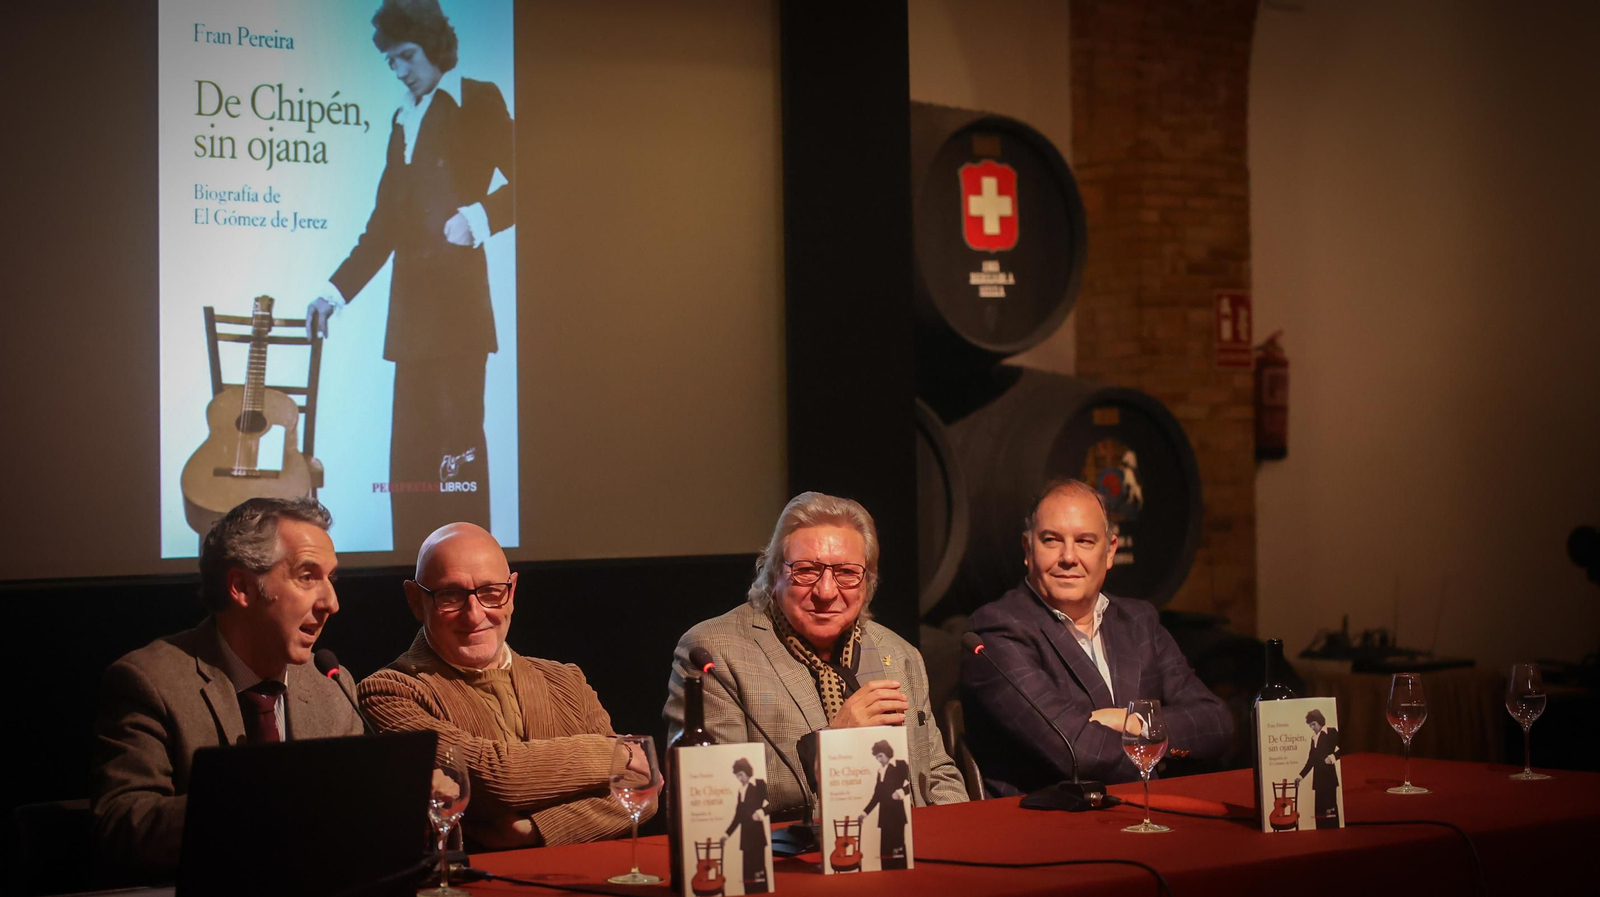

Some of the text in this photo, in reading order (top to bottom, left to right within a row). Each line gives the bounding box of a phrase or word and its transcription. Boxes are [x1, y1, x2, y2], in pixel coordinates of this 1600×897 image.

[193, 23, 295, 51] Fran Pereira
[193, 79, 371, 134] De Chipén,
[193, 122, 329, 172] sin ojana
[193, 184, 281, 205] Biografía de
[193, 207, 328, 232] El Gómez de Jerez
[440, 481, 477, 492] LIBROS
[1268, 734, 1278, 744] De
